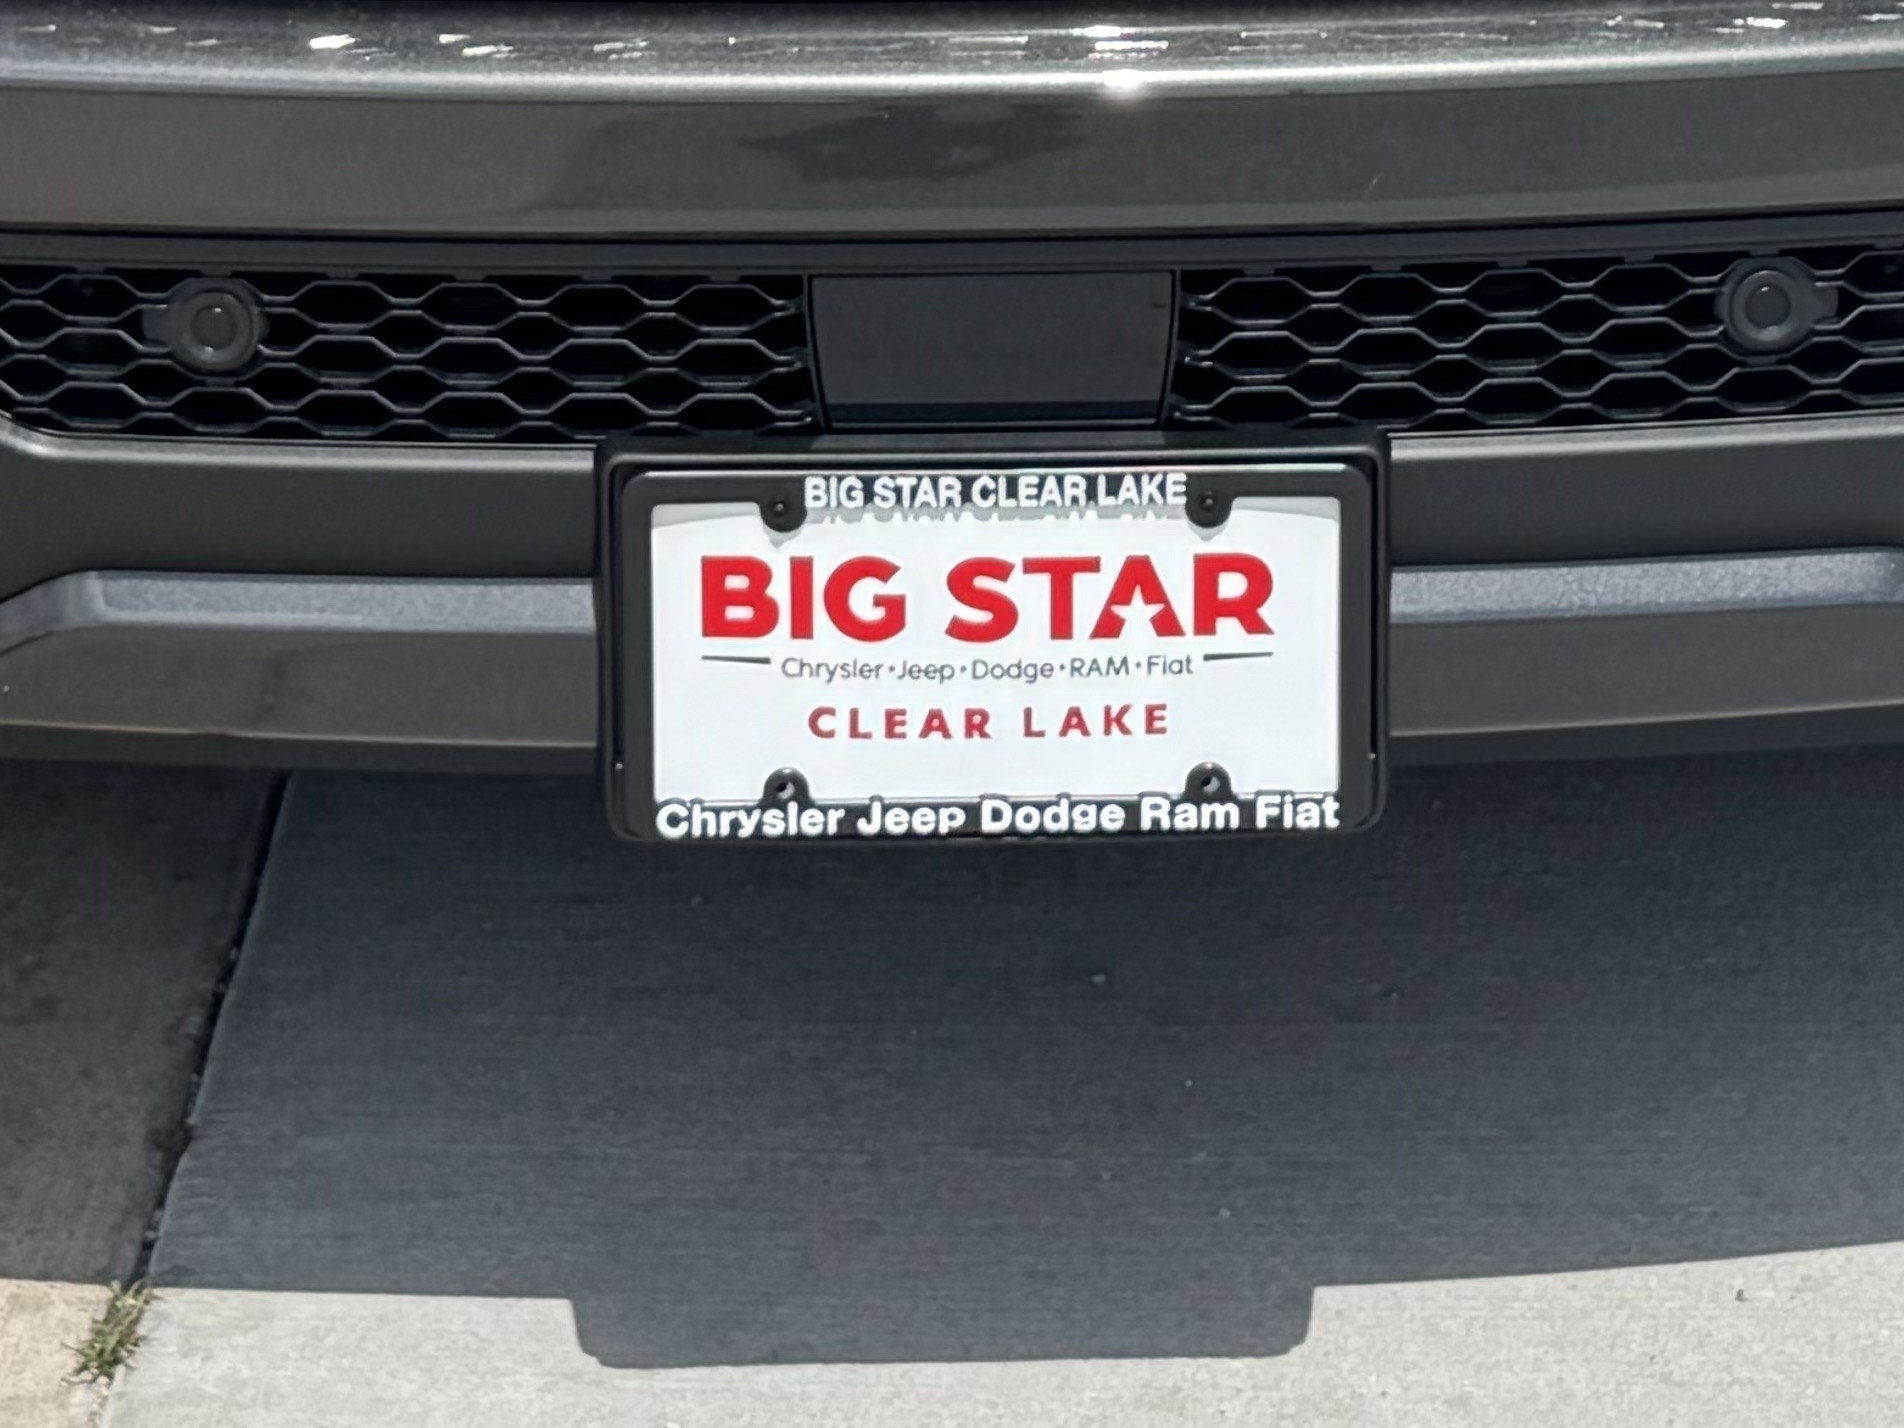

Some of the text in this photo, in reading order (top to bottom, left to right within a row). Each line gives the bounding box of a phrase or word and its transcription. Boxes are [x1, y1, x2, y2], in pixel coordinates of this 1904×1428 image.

[804, 472, 1188, 509] BIG STAR CLEAR LAKE
[700, 552, 1275, 644] BIG STAR
[780, 653, 1194, 685] Chrysler Jeep Dodge RAM Fiat
[807, 702, 1168, 740] CLEAR LAKE
[656, 793, 1341, 839] Chrysler Jeep Dodge Ram Fiat
